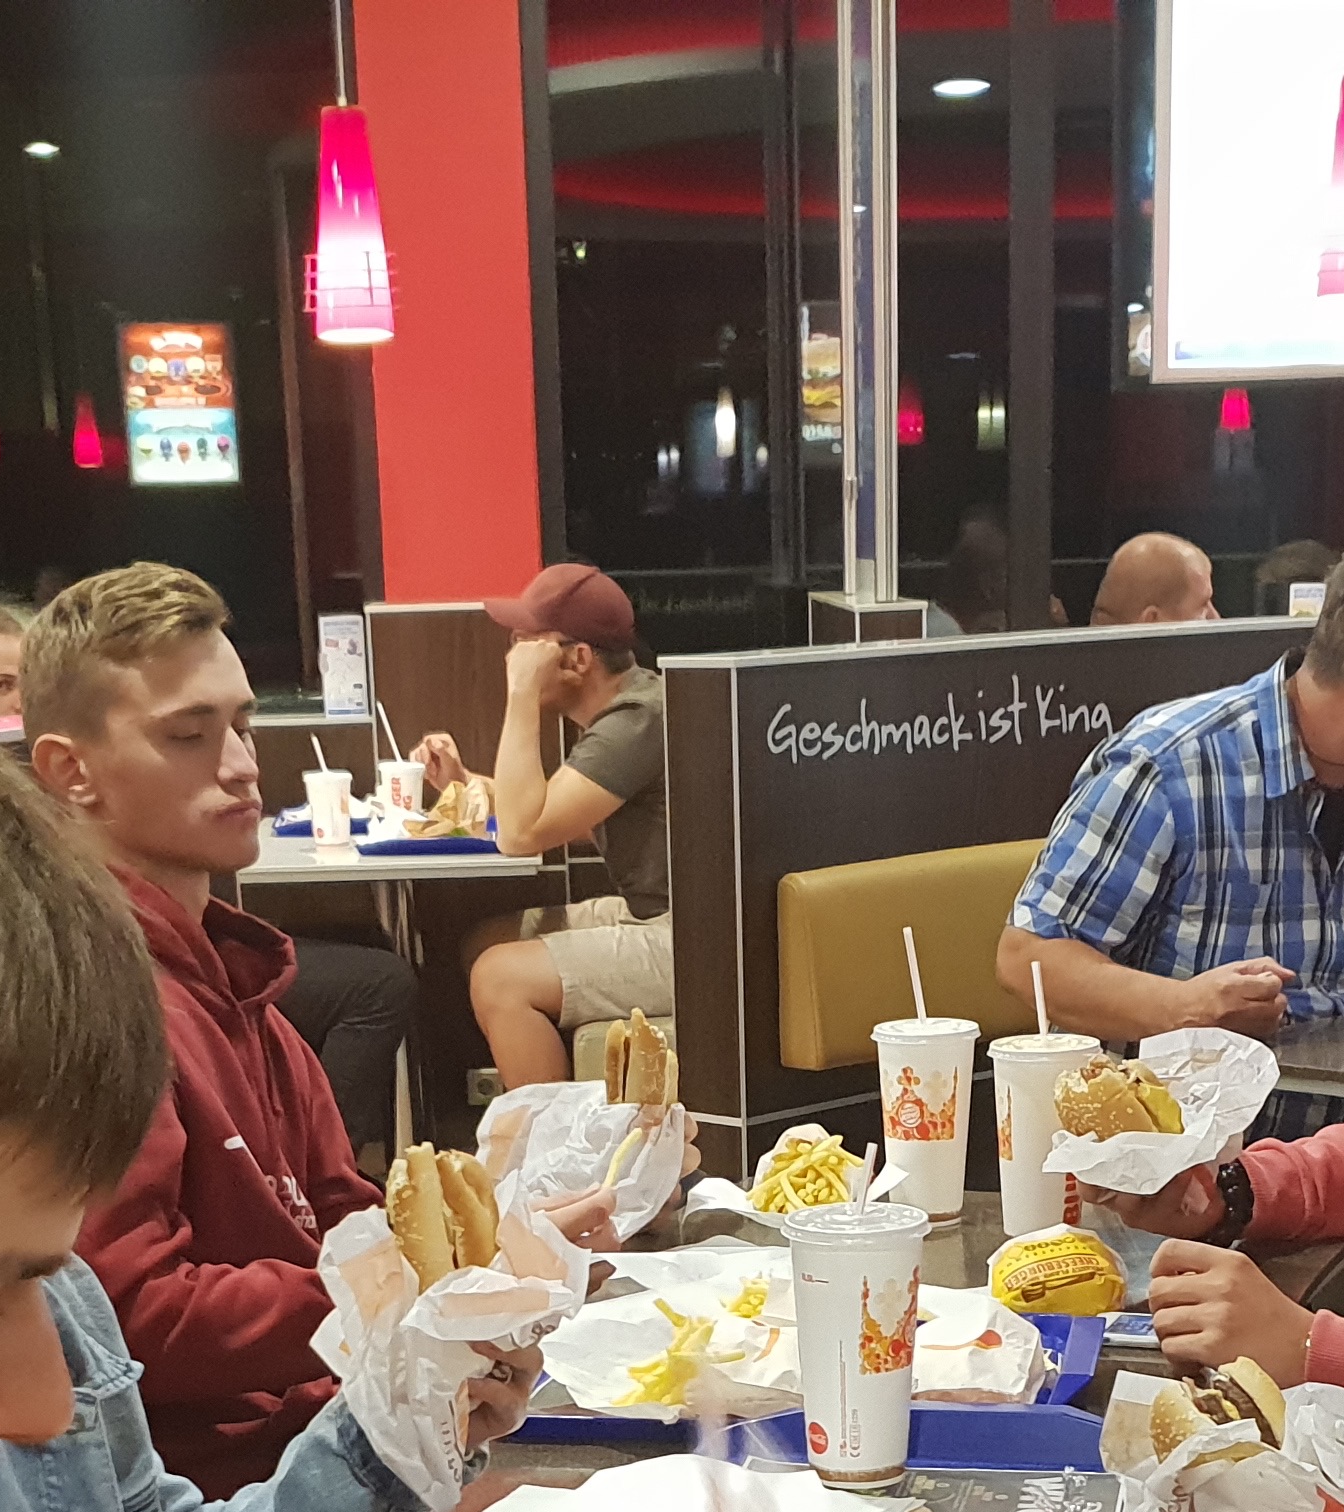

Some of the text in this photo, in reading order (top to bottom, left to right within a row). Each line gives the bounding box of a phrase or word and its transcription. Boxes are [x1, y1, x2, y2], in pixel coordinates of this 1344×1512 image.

[767, 673, 1113, 765] Geschmack ist King
